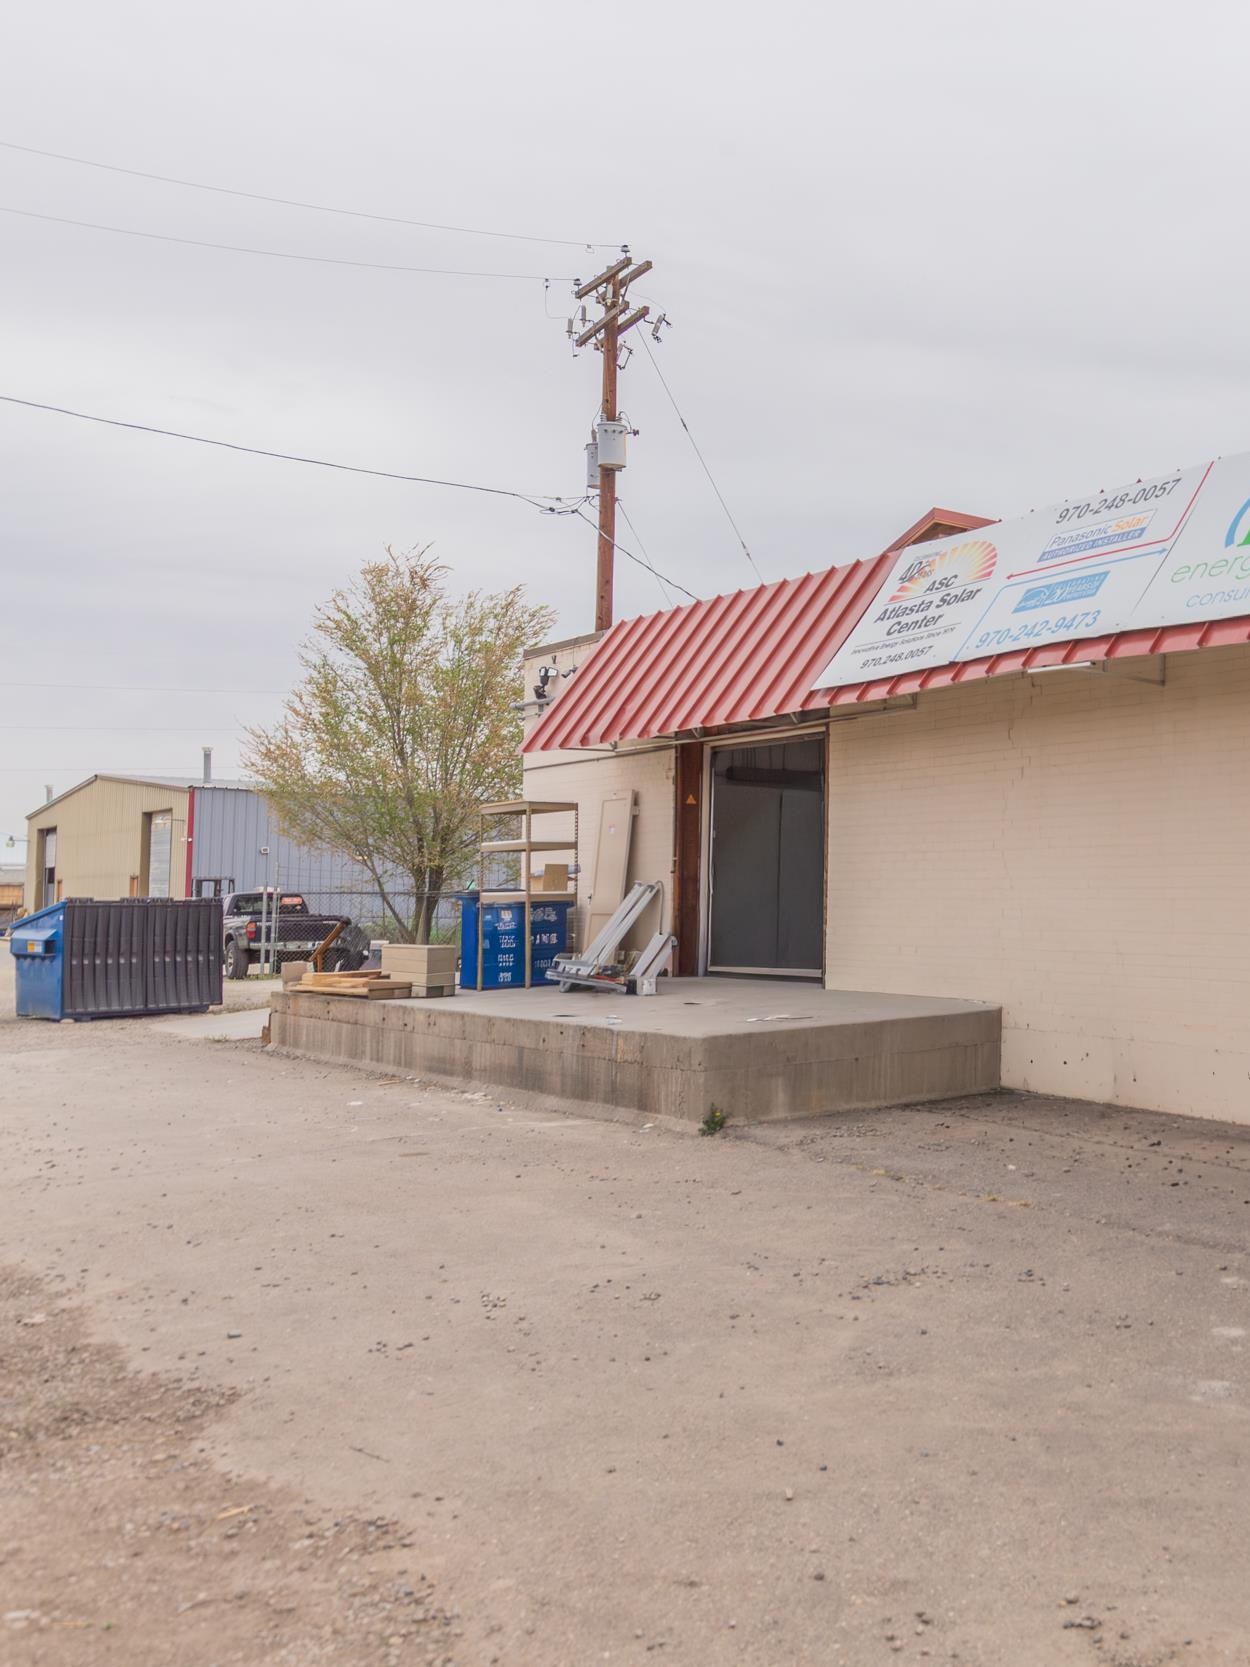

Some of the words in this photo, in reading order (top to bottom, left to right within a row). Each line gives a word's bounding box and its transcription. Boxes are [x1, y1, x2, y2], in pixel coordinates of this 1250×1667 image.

[1056, 477, 1182, 524] 970-248-0057
[1052, 523, 1112, 549] Panasonic
[1110, 515, 1149, 533] Solar
[1093, 530, 1144, 549] INSTALLER
[923, 574, 958, 594] ASC
[874, 599, 934, 624] Atlasta
[935, 586, 982, 609] Solar
[885, 613, 944, 637] Center
[975, 610, 1102, 650] 970-242-9473
[859, 645, 935, 670] 970.248.0057
[879, 640, 898, 650] Energy
